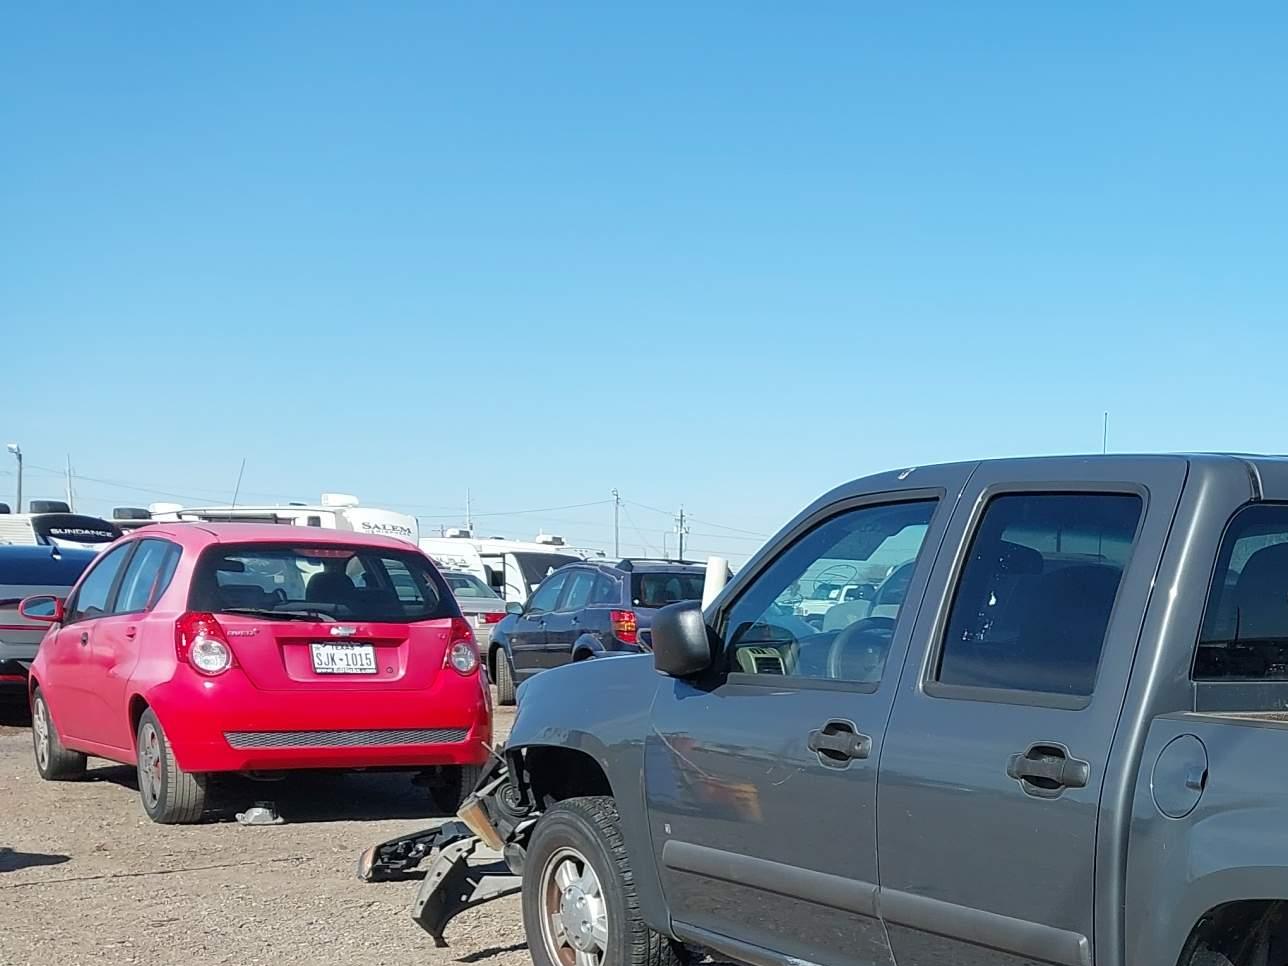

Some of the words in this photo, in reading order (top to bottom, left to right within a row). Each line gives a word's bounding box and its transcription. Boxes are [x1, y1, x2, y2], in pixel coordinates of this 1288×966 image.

[50, 528, 113, 537] SUNDANCE
[361, 521, 413, 534] SALEM
[315, 652, 372, 667] SJK-1015
